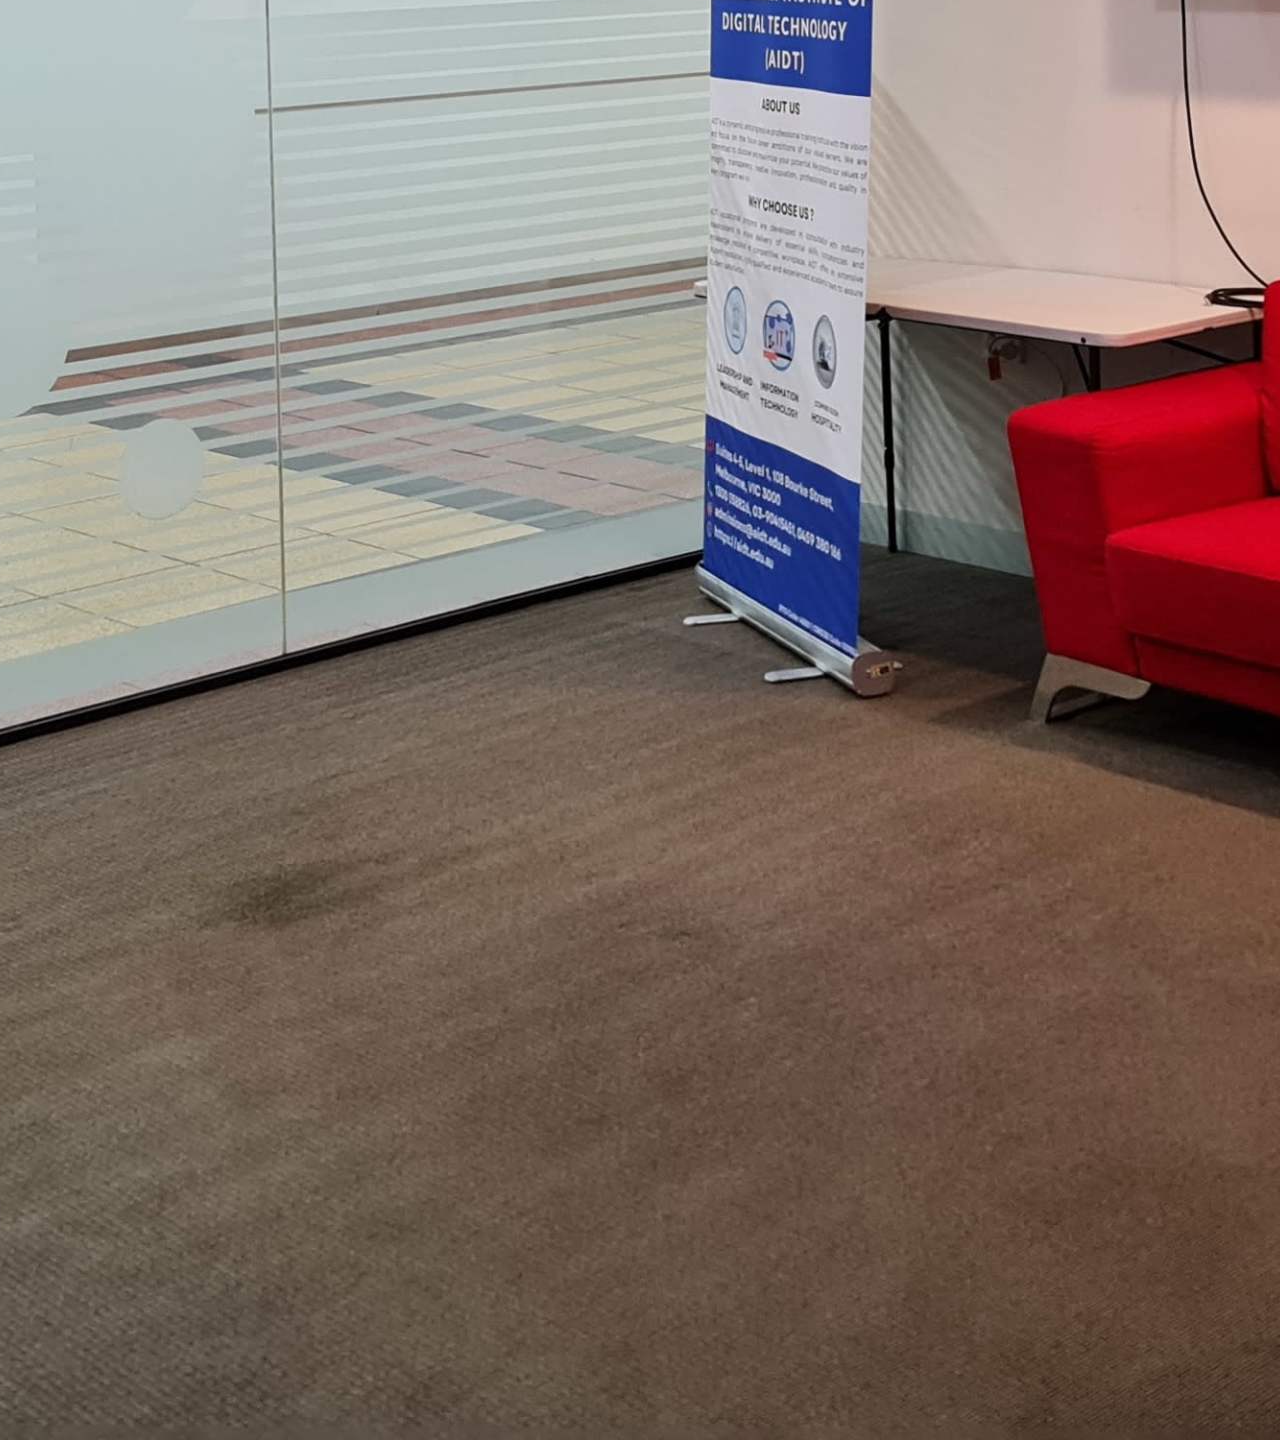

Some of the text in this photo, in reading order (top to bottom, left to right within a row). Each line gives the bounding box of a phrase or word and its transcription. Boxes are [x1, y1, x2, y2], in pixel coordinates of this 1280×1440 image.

[722, 12, 847, 41] DIGITAL TECHNOLOGY
[765, 48, 804, 75] (AIDT)
[761, 98, 801, 115] ABOUT US
[748, 194, 762, 210] WHY
[762, 199, 798, 218] CHOOSE
[799, 206, 809, 220] US
[760, 381, 799, 402] INFORMATION
[760, 397, 798, 418] TECHNOLOGY
[745, 457, 765, 476] Level
[785, 473, 809, 498] Bourke
[748, 480, 761, 497] VIC
[762, 486, 781, 506] 3000
